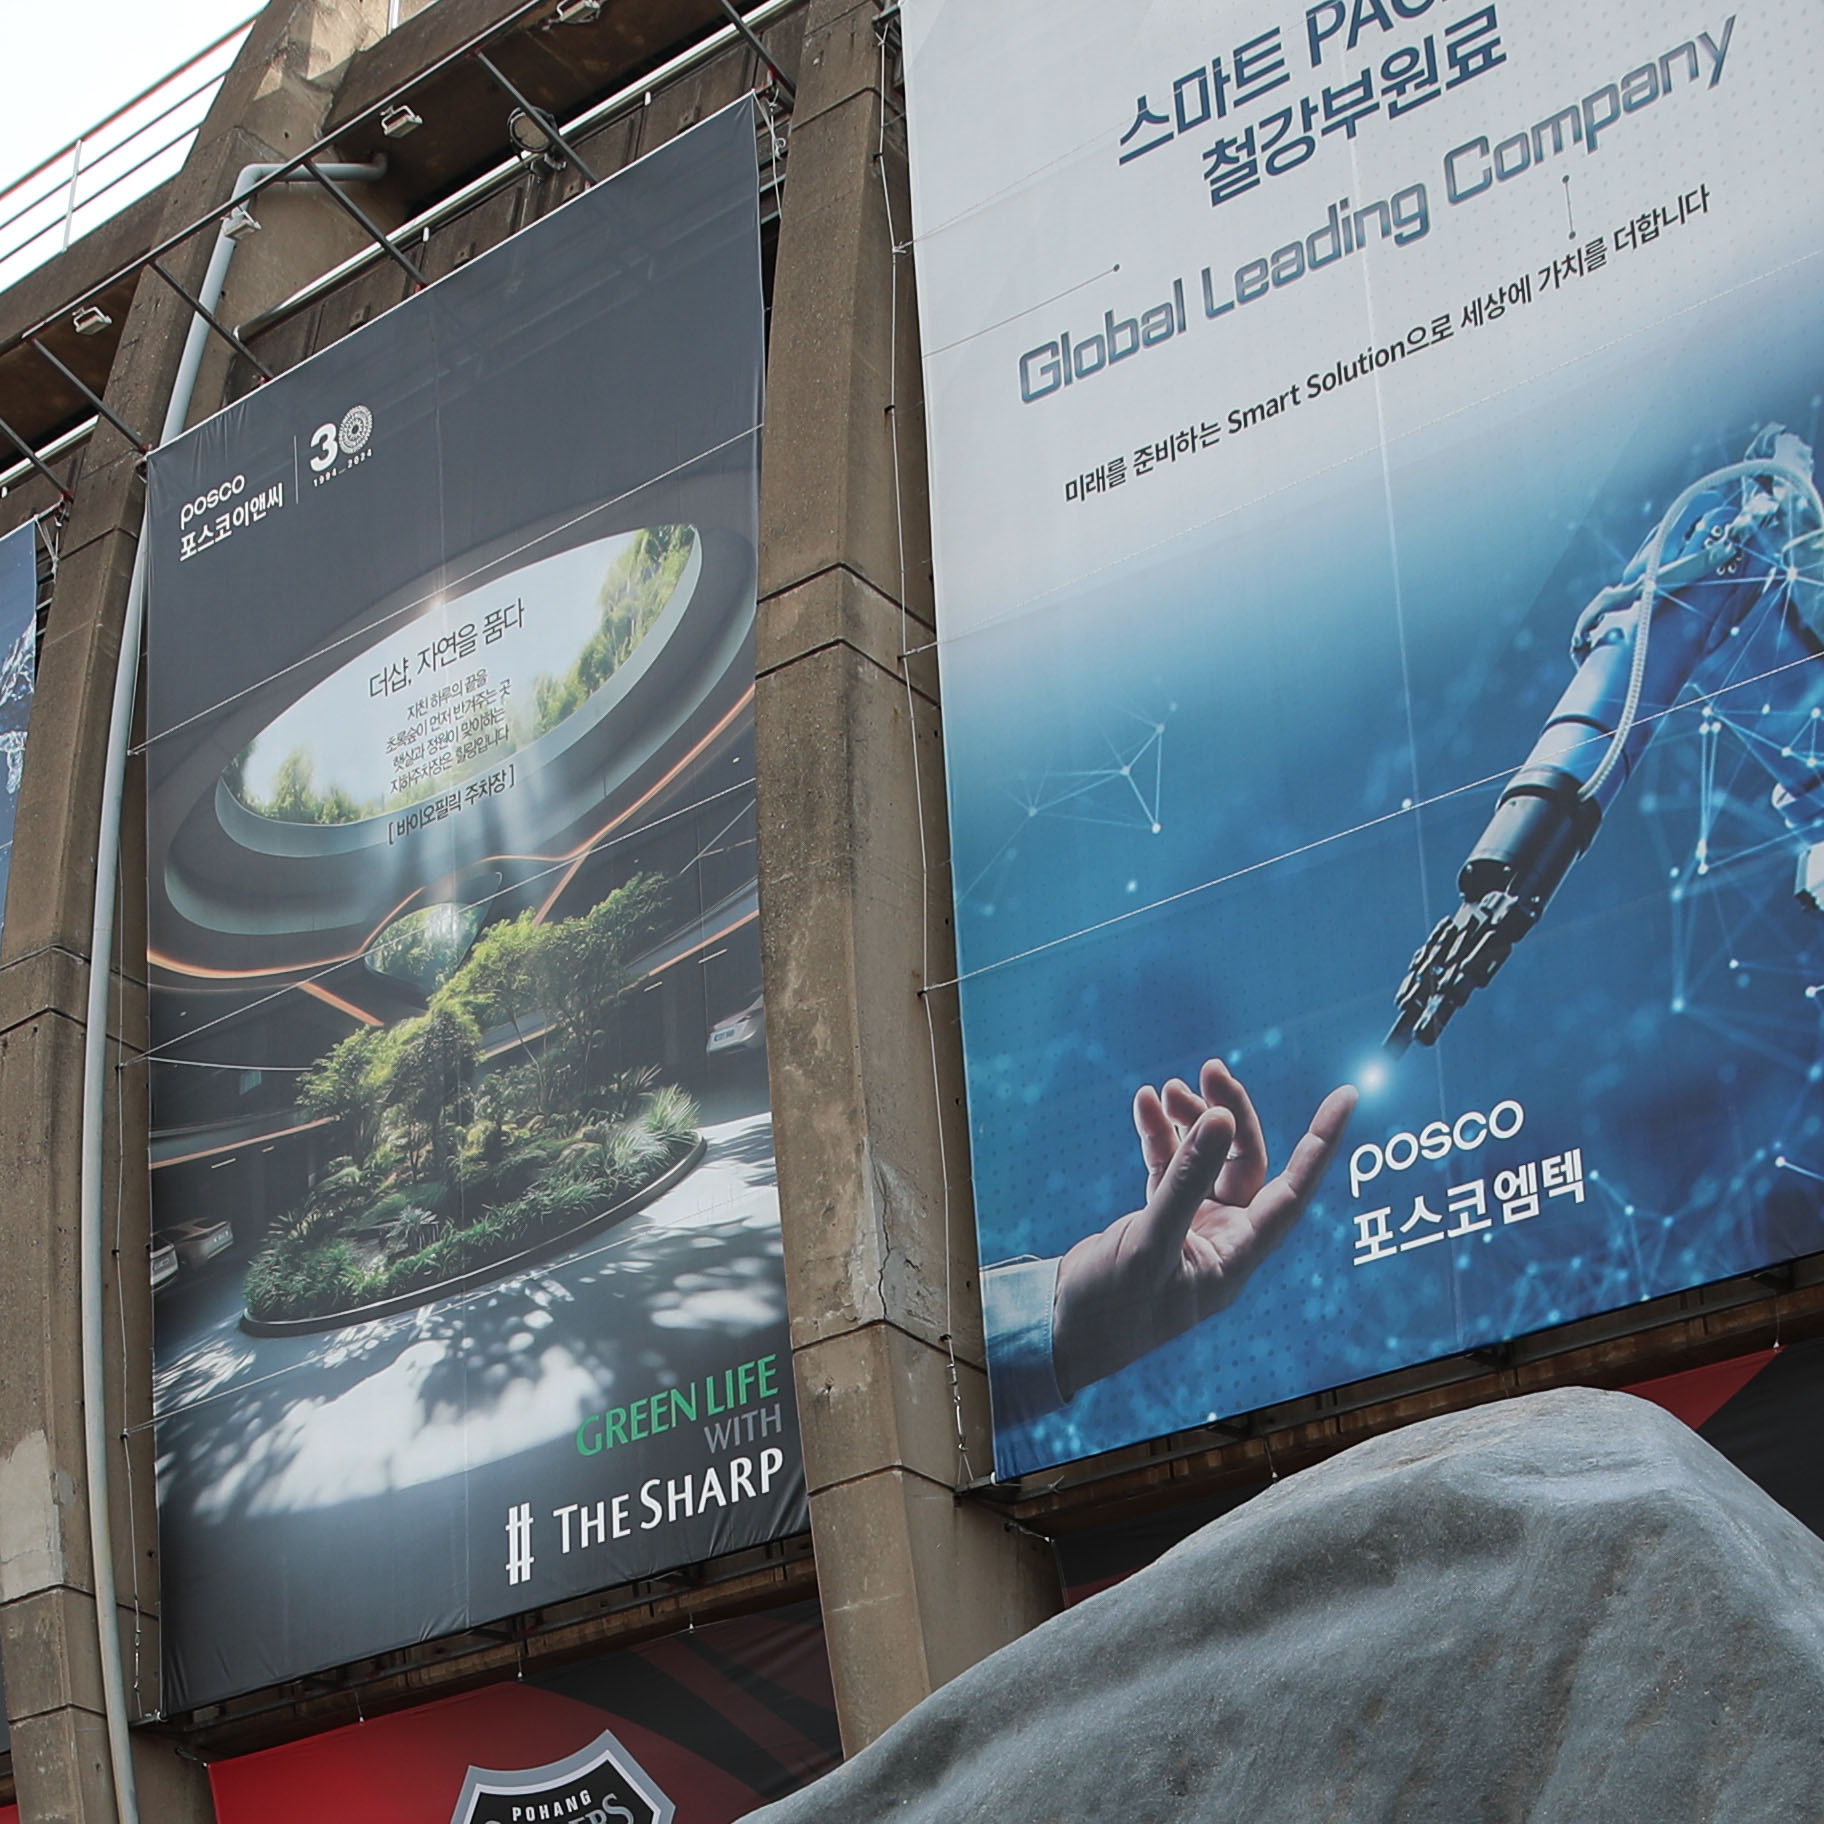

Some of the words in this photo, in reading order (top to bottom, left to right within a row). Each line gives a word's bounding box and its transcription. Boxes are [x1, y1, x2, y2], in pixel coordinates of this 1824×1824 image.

[1118, 25, 1291, 166] 스마트
[1202, 3, 1508, 207] 철강부원료
[1019, 280, 1187, 405] Global
[1200, 183, 1430, 319] Leading
[1444, 14, 1738, 205] Company
[1064, 456, 1127, 504] 미래를
[1132, 420, 1221, 484] 준비하는
[1227, 383, 1300, 436] Smart
[1306, 312, 1455, 401] Solution으로
[1459, 275, 1532, 333] 세상에
[1536, 237, 1608, 297] 가치를
[1612, 183, 1712, 255] 더합니다
[179, 474, 246, 530] posco
[179, 481, 285, 562] 포스코이앤씨
[416, 623, 478, 687] 자연을
[482, 597, 525, 647] 품다
[396, 791, 462, 836] 바이오필릭
[464, 769, 507, 804] 주차장
[1349, 1098, 1525, 1197] posco
[1351, 1147, 1586, 1268] 포스코엠텍
[577, 1388, 698, 1457] GREEN
[704, 1354, 779, 1414] LIFE
[703, 1403, 783, 1454] WITH
[552, 1492, 631, 1555] THE
[640, 1447, 784, 1531] SHARP
[511, 1788, 592, 1823] POHANG
